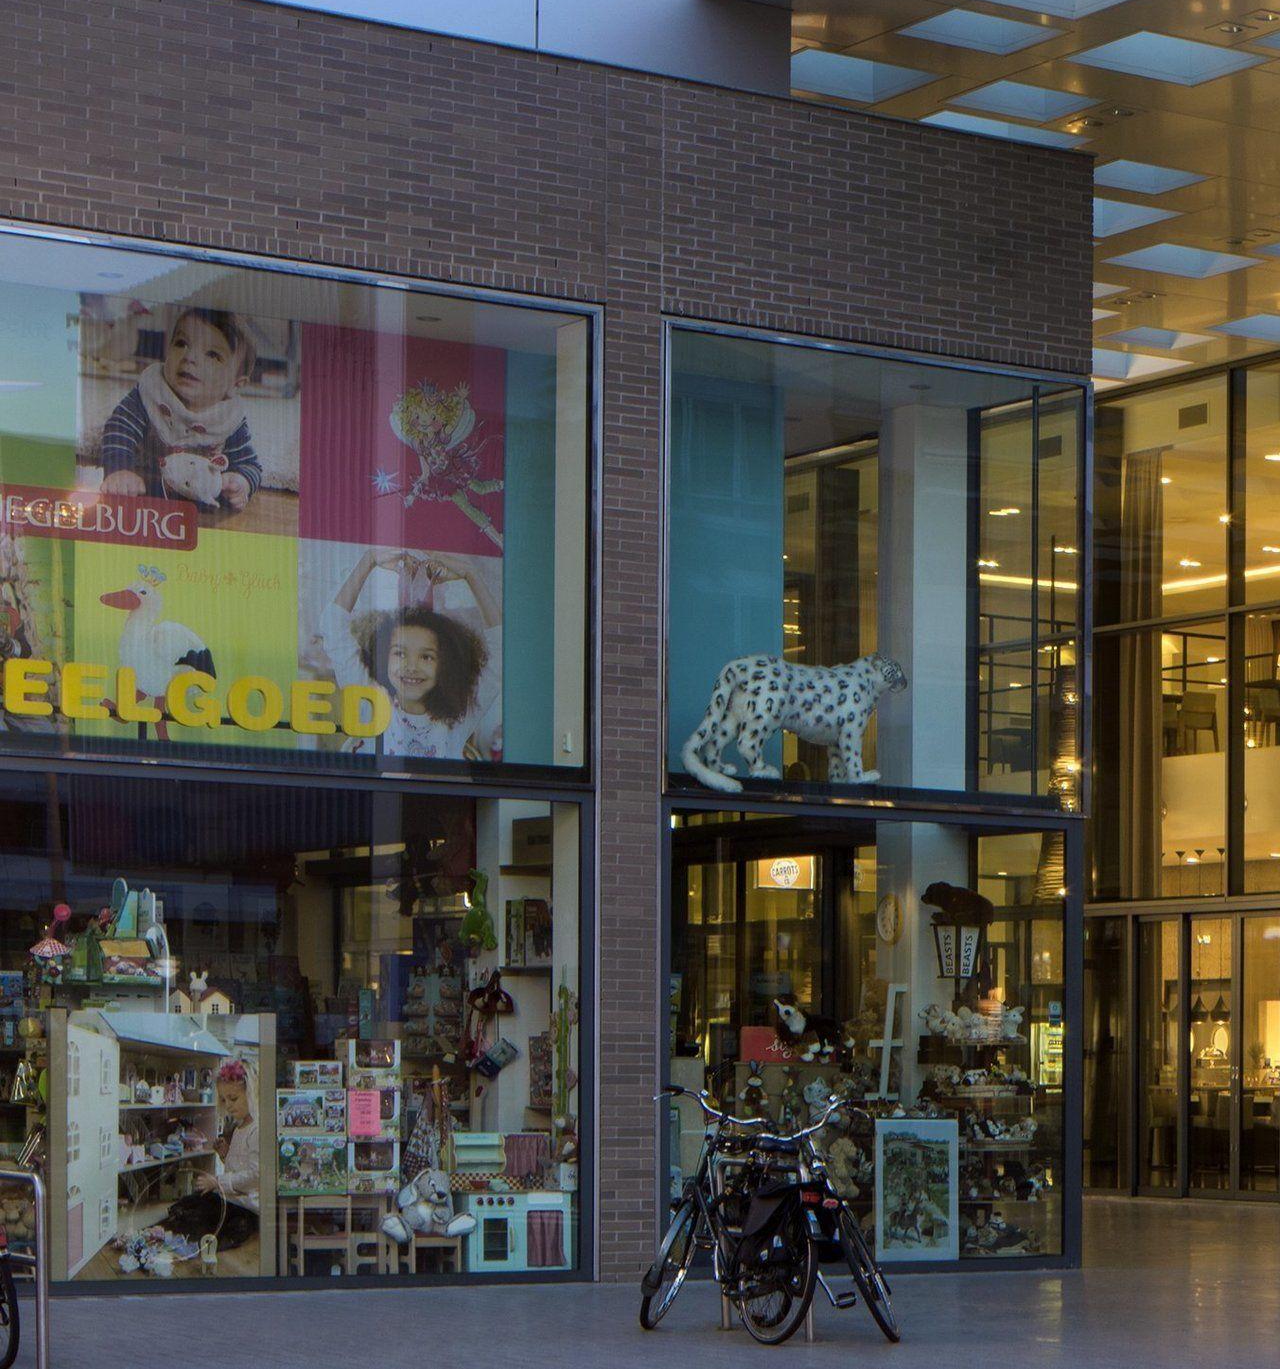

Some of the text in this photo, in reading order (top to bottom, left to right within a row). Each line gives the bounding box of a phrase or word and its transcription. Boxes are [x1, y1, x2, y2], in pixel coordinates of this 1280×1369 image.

[4, 657, 392, 737] EELGOED
[771, 865, 799, 878] CARROTS
[943, 934, 954, 974] BEASTS
[961, 935, 973, 975] BEASTS
